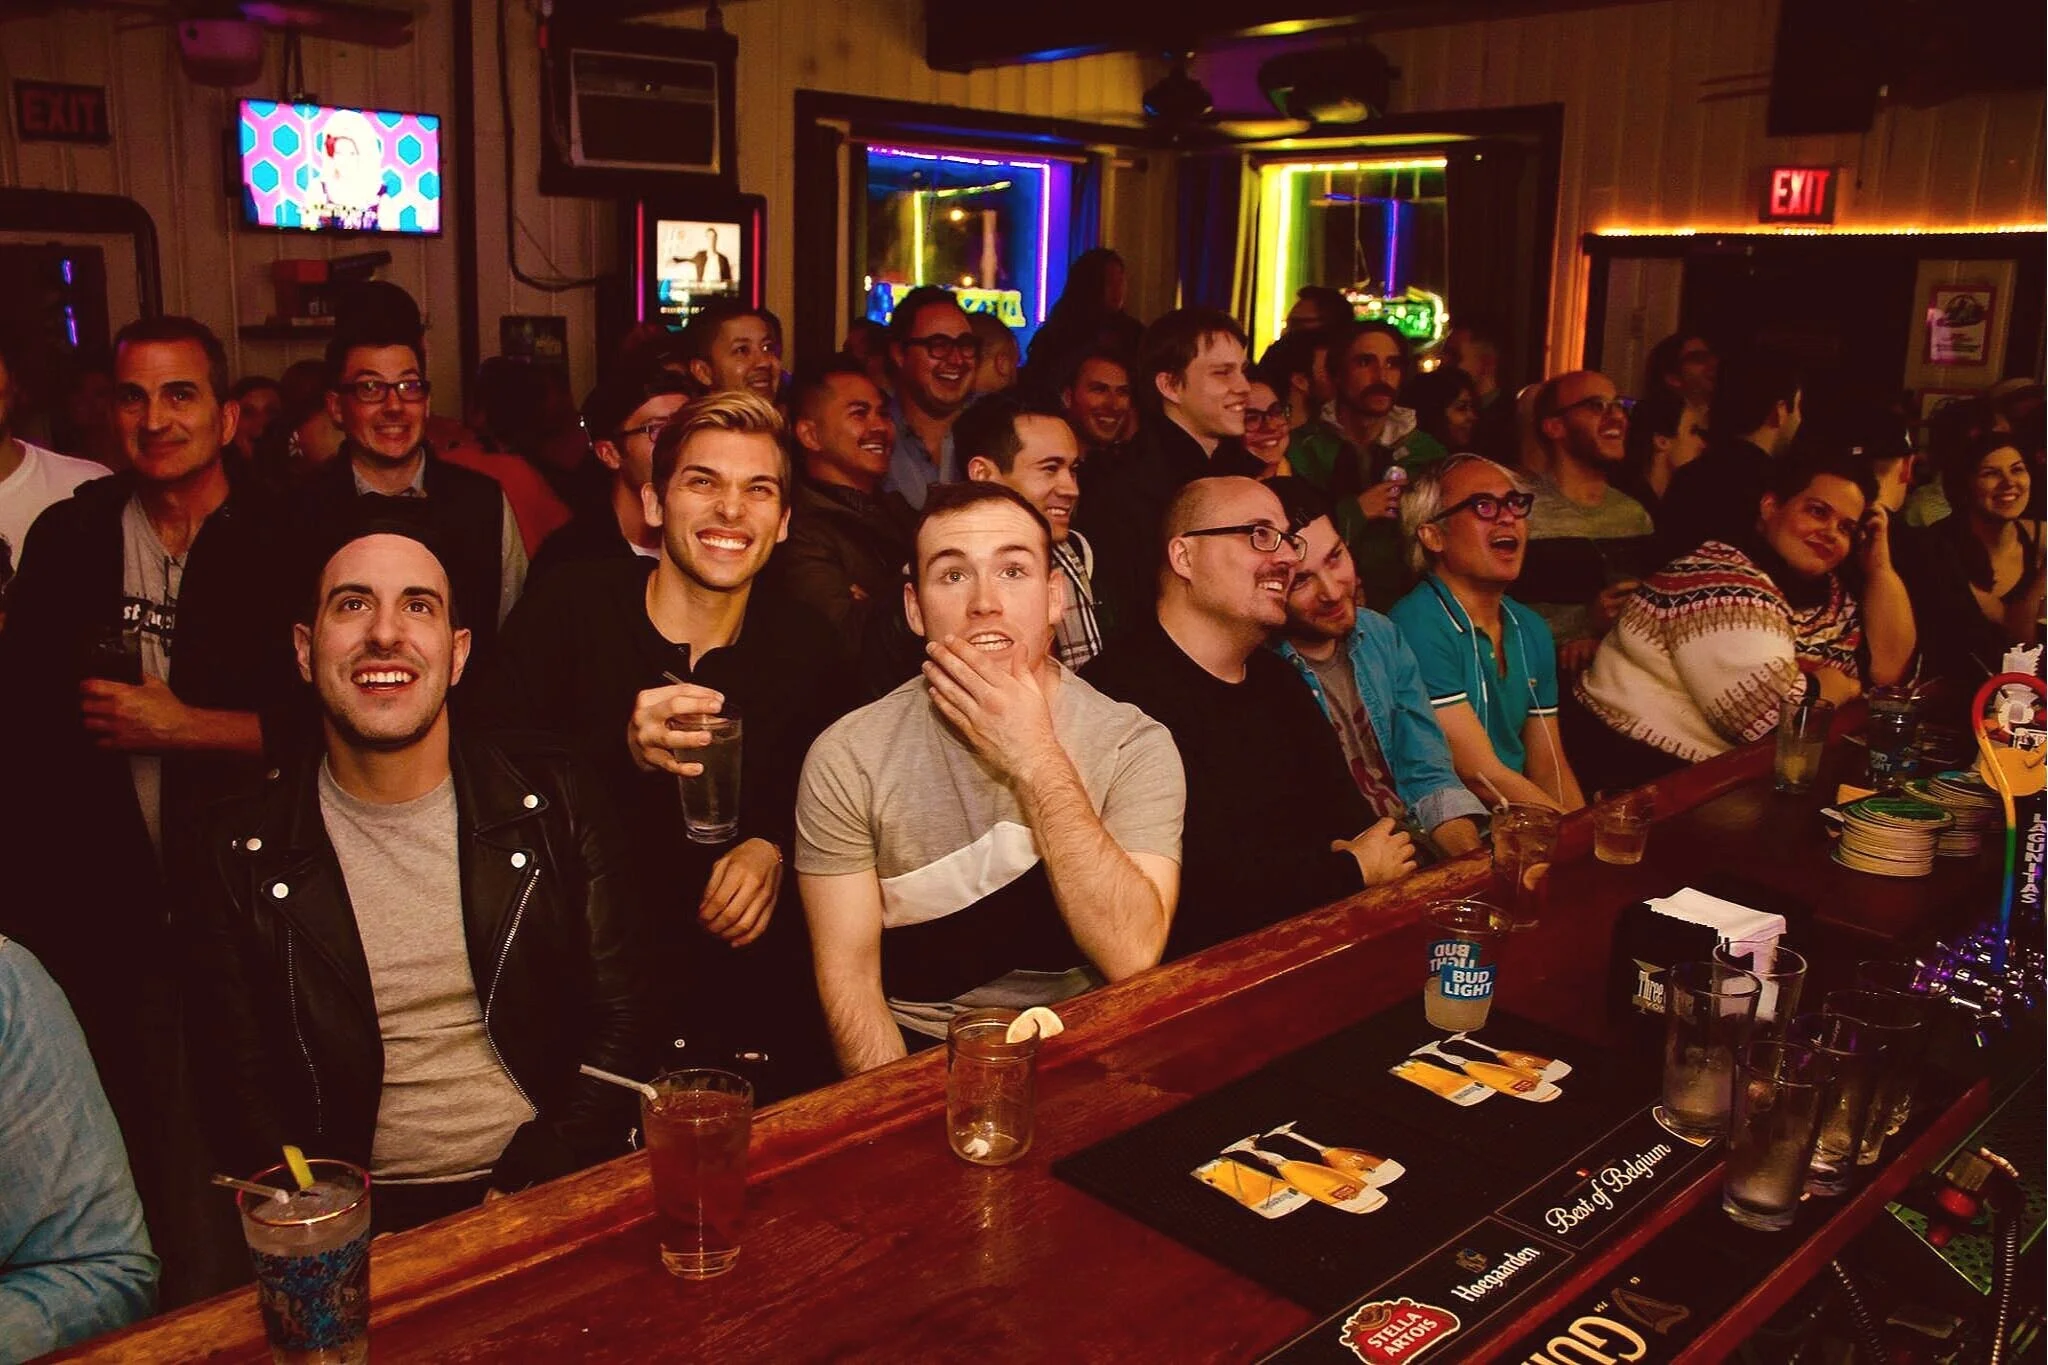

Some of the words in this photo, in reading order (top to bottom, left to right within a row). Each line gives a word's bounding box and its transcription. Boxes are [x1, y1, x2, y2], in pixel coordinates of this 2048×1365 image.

[22, 90, 98, 134] EXIT
[1769, 169, 1830, 216] EXIT
[2020, 812, 2047, 904] LAGUNITAS
[1444, 981, 1493, 997] LIGHT
[1452, 970, 1490, 984] BUD
[1600, 1143, 1672, 1193] Belgium
[1591, 1178, 1614, 1210] of
[1545, 1198, 1596, 1234] Best
[1450, 1247, 1541, 1302] Hoegaarden
[1367, 1312, 1423, 1348] STELLA
[1383, 1318, 1438, 1357] ARTOIS
